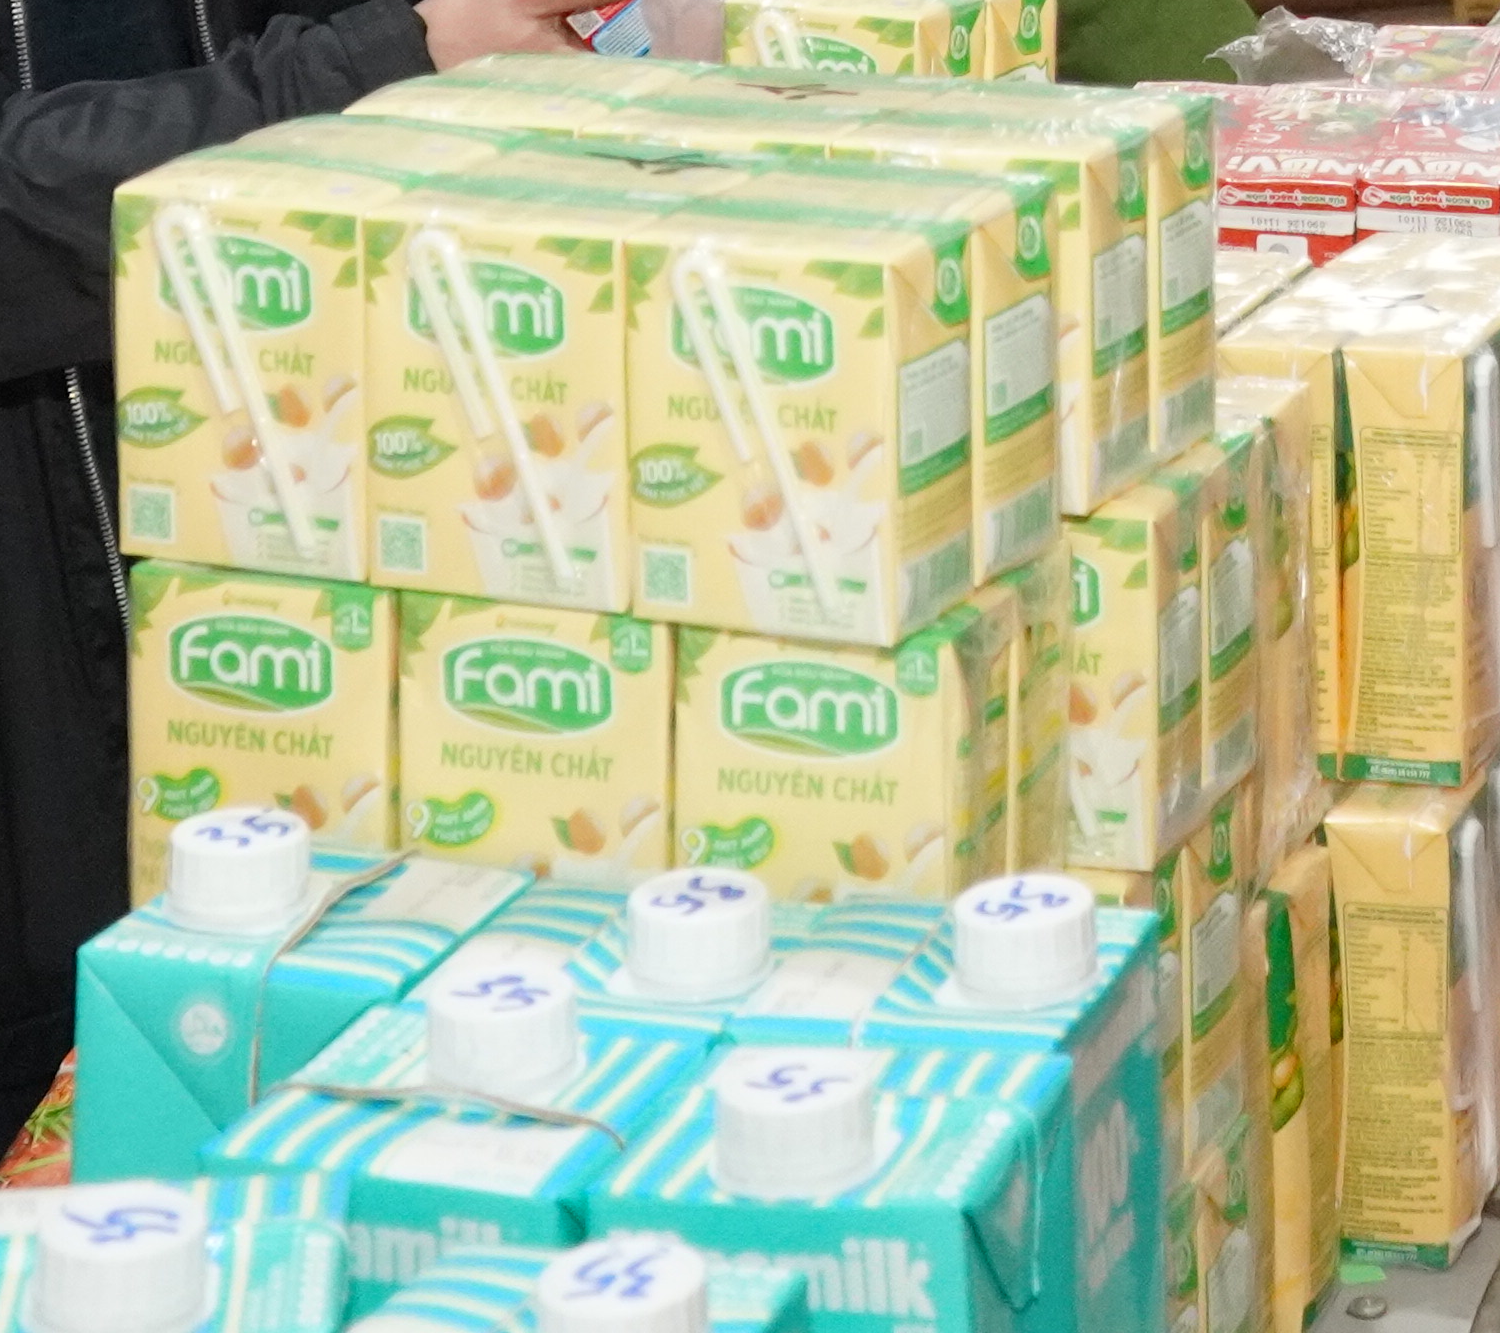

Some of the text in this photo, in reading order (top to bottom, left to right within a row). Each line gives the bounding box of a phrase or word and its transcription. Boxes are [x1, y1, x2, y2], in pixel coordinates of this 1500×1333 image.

[124, 402, 173, 424] 100%
[374, 431, 423, 455] 100%
[637, 459, 687, 485] 100%
[166, 718, 335, 761] NGUYÊN CHẤT
[440, 742, 615, 784] NGUYÊN CHẤT
[137, 775, 158, 815] 9
[717, 765, 900, 809] NGUYÊN CHẤT
[406, 799, 430, 839] 9
[680, 826, 707, 866] 9
